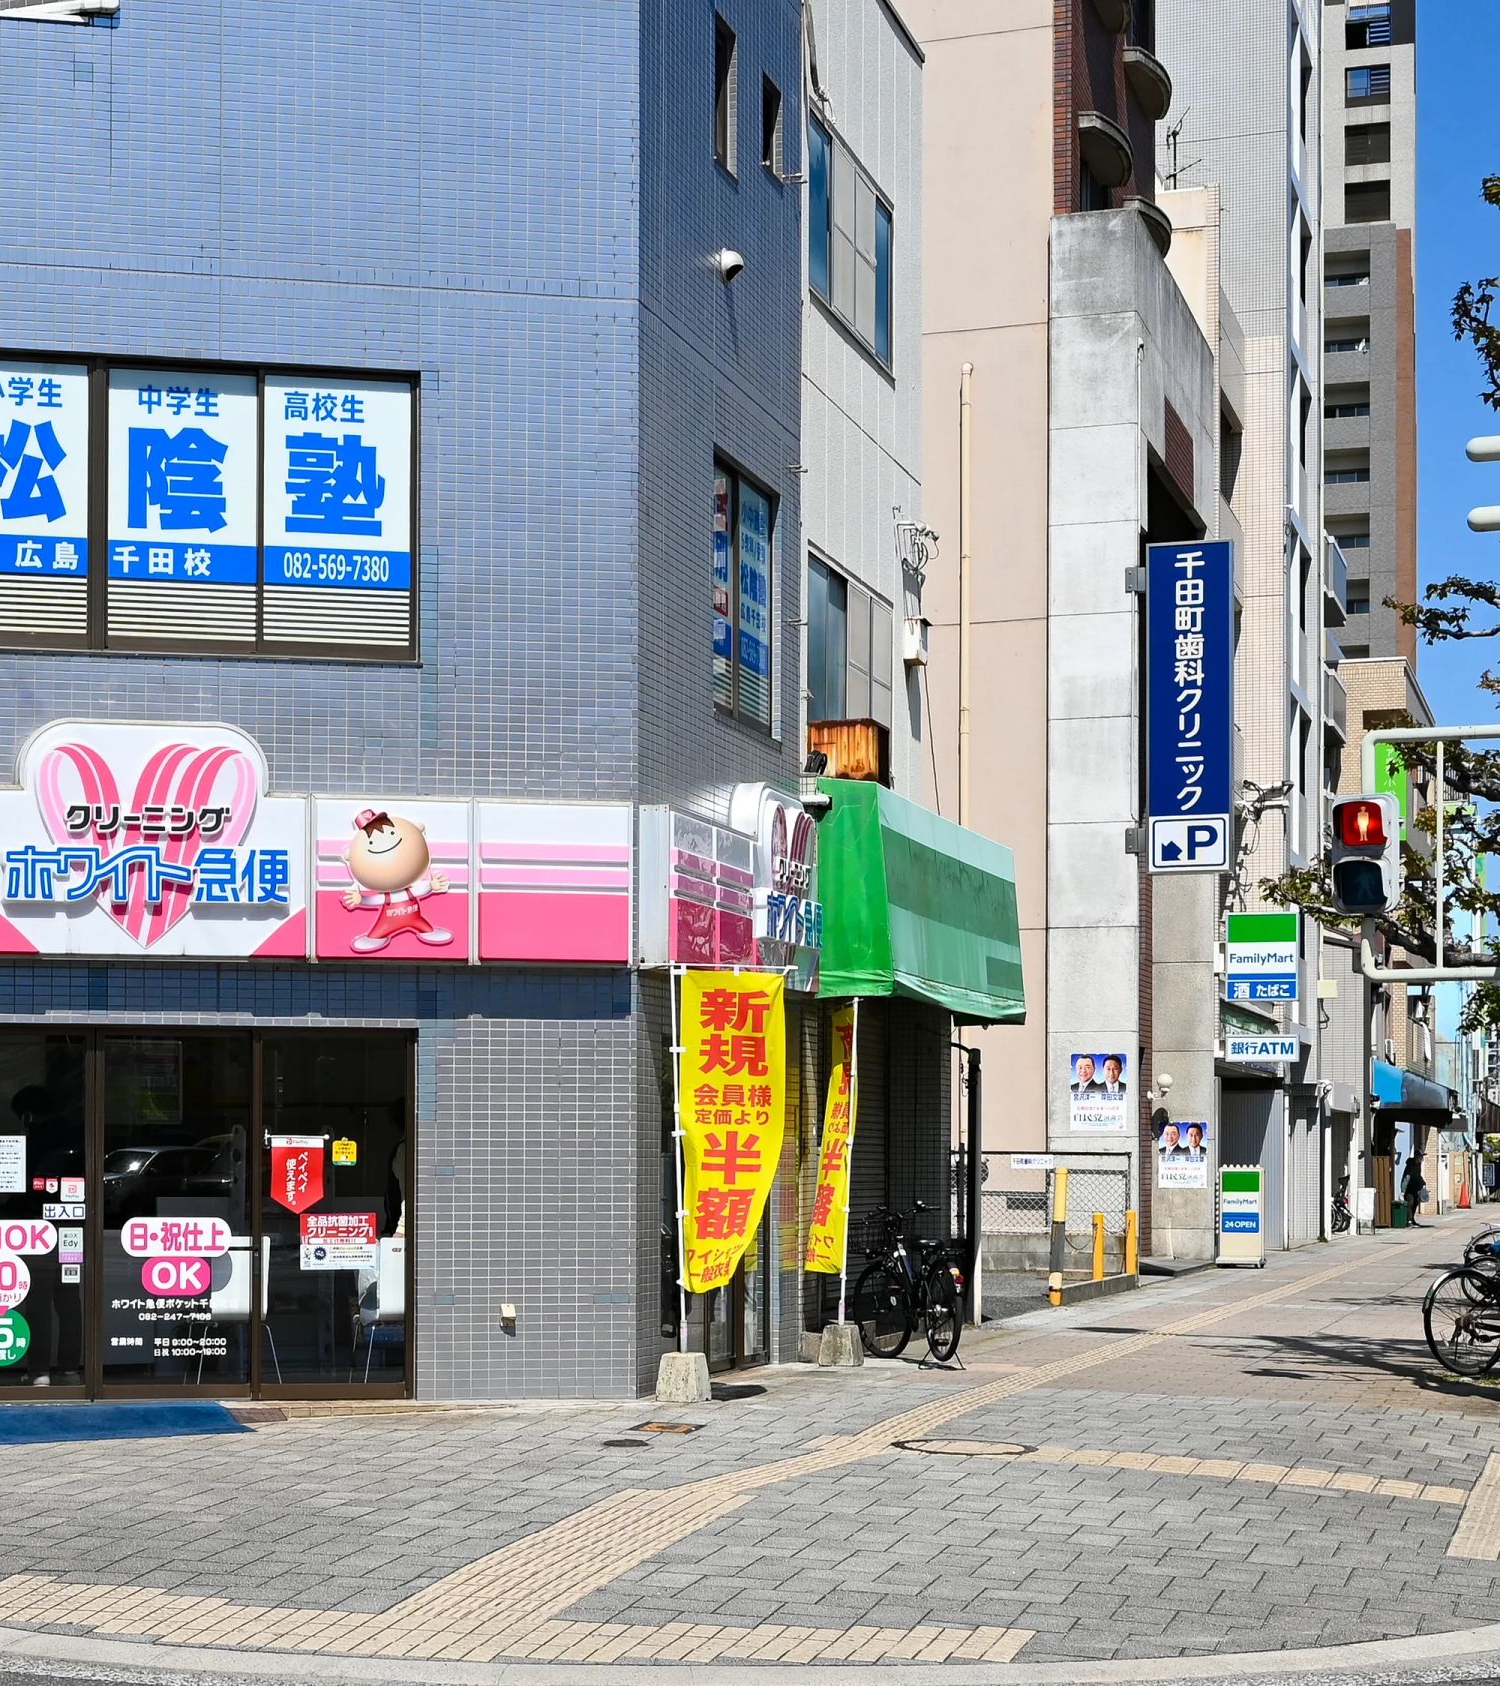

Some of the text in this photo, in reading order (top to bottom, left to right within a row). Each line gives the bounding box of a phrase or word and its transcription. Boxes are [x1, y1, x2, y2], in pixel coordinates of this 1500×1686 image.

[137, 384, 220, 418] 中学生
[284, 391, 365, 423] 高校生
[128, 427, 229, 533] 陰
[285, 433, 386, 537] 塾
[14, 540, 211, 577] 広島 千田校
[283, 552, 389, 582] 082-569-7380
[1174, 551, 1205, 811] 千田町歯科クリニック
[67, 806, 232, 832] クリーニング
[1187, 825, 1218, 860] P
[6, 845, 289, 904] ホワイト急便
[1229, 953, 1294, 966] FamilyMart
[1233, 983, 1290, 998] 酒 たばこ
[700, 988, 770, 1076] 新規
[1231, 1042, 1294, 1055] 銀行ATM
[694, 1084, 772, 1108] 会員様
[694, 1109, 770, 1125] 定価より
[298, 1151, 308, 1192] ペイペイ
[696, 1131, 762, 1240] 半額
[44, 1206, 85, 1218] 出入口
[1223, 1198, 1257, 1206] FamilyMart
[307, 1216, 369, 1227] 全品抗菌加工
[154, 1261, 202, 1290] OK
[15, 1339, 26, 1348] 時
